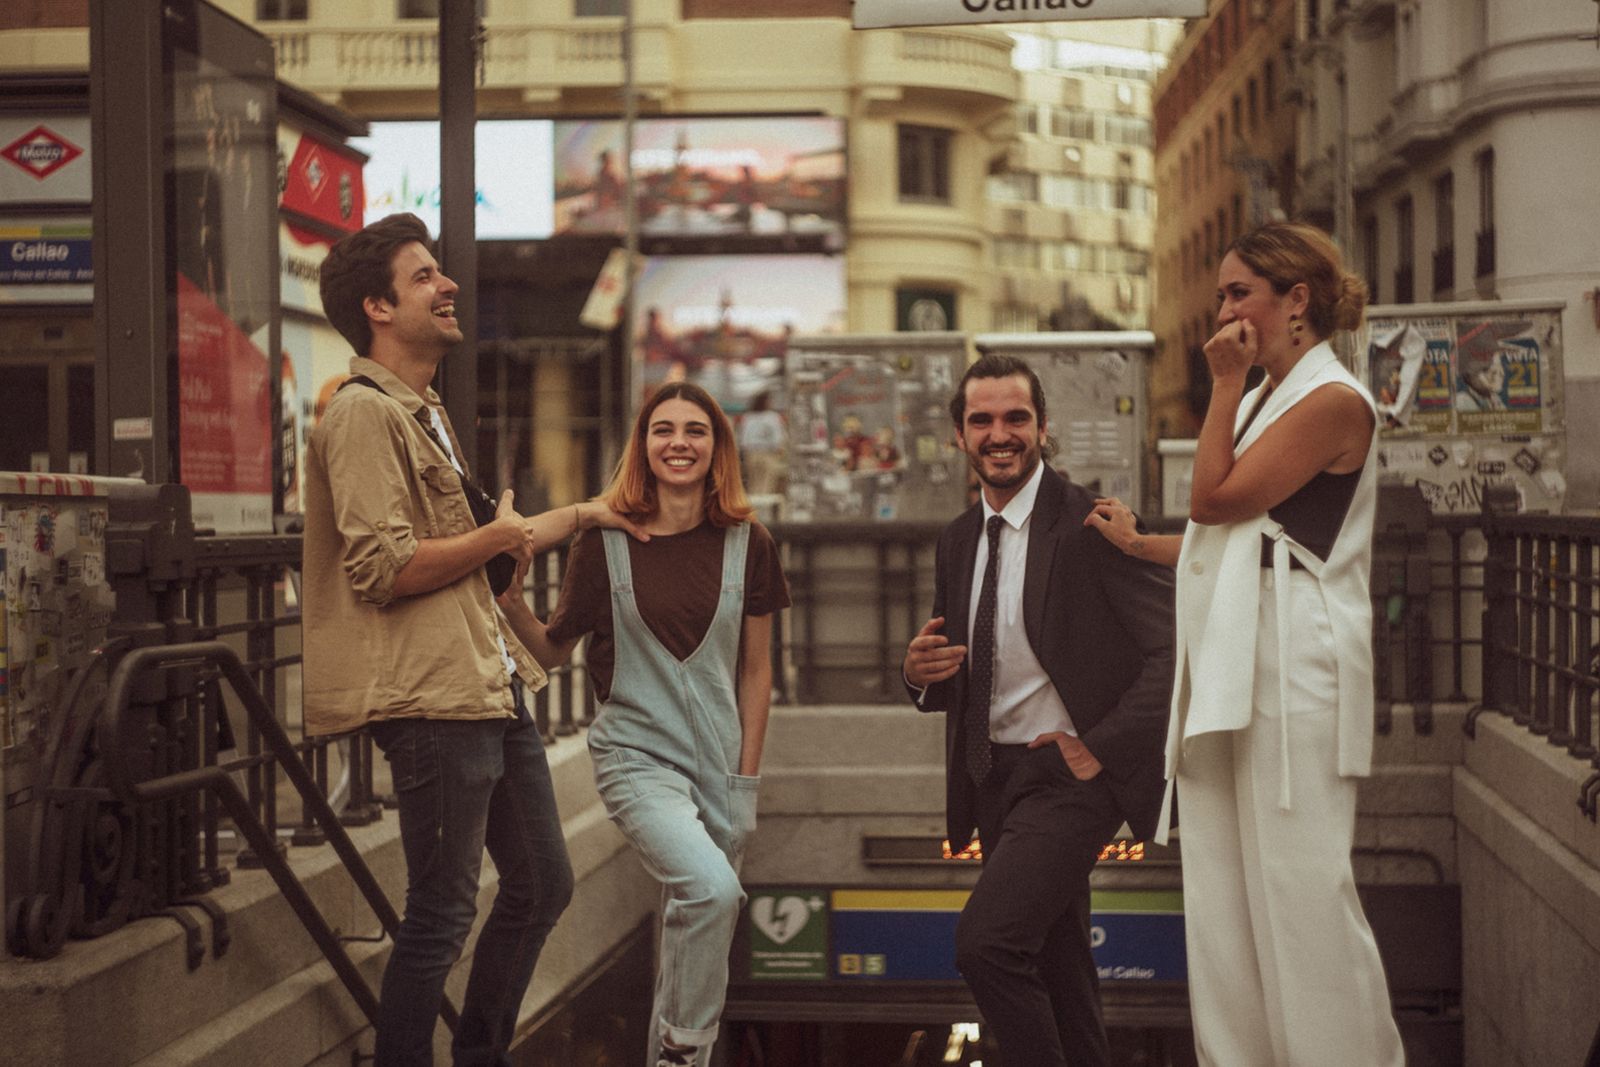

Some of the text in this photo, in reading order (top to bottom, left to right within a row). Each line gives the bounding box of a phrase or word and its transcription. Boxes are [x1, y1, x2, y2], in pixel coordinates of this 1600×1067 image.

[11, 241, 69, 261] Callao
[1420, 364, 1448, 388] 21
[1507, 362, 1538, 386] 21
